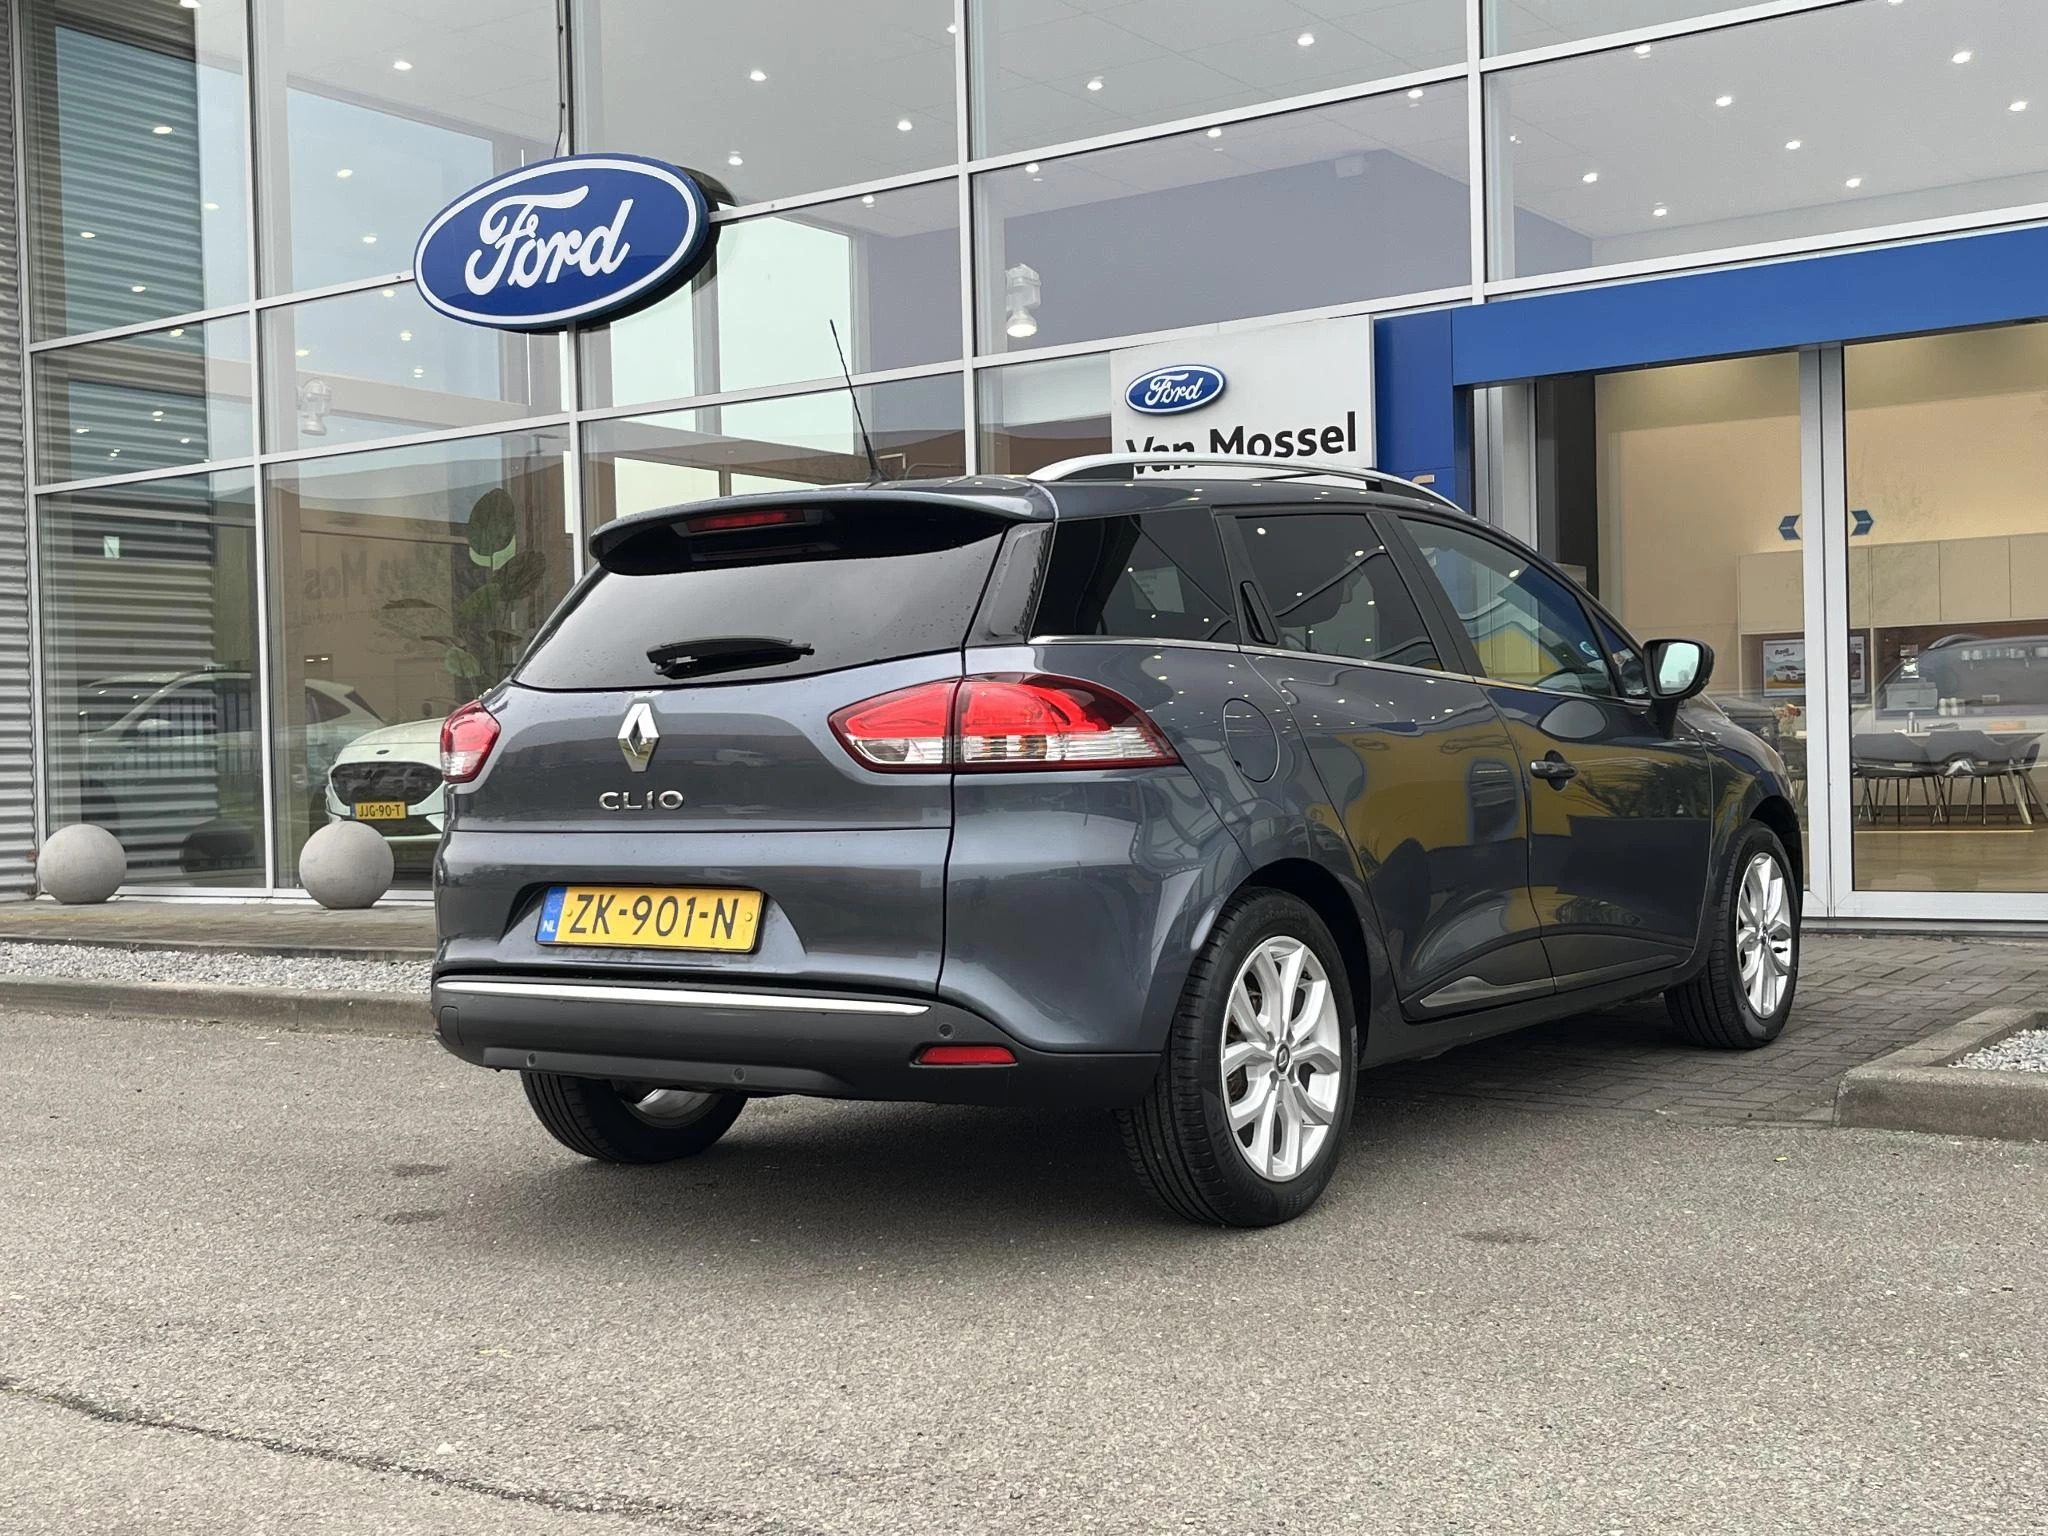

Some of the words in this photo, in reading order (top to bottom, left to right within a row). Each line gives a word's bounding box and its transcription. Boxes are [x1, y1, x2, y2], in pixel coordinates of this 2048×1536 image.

[465, 185, 634, 296] Ford
[1144, 373, 1204, 406] Ford
[1209, 411, 1356, 459] Mossel
[359, 804, 401, 817] JJG-90-T
[599, 790, 684, 811] CLIO
[542, 919, 556, 932] NL
[569, 894, 740, 940] ZK-901-N
